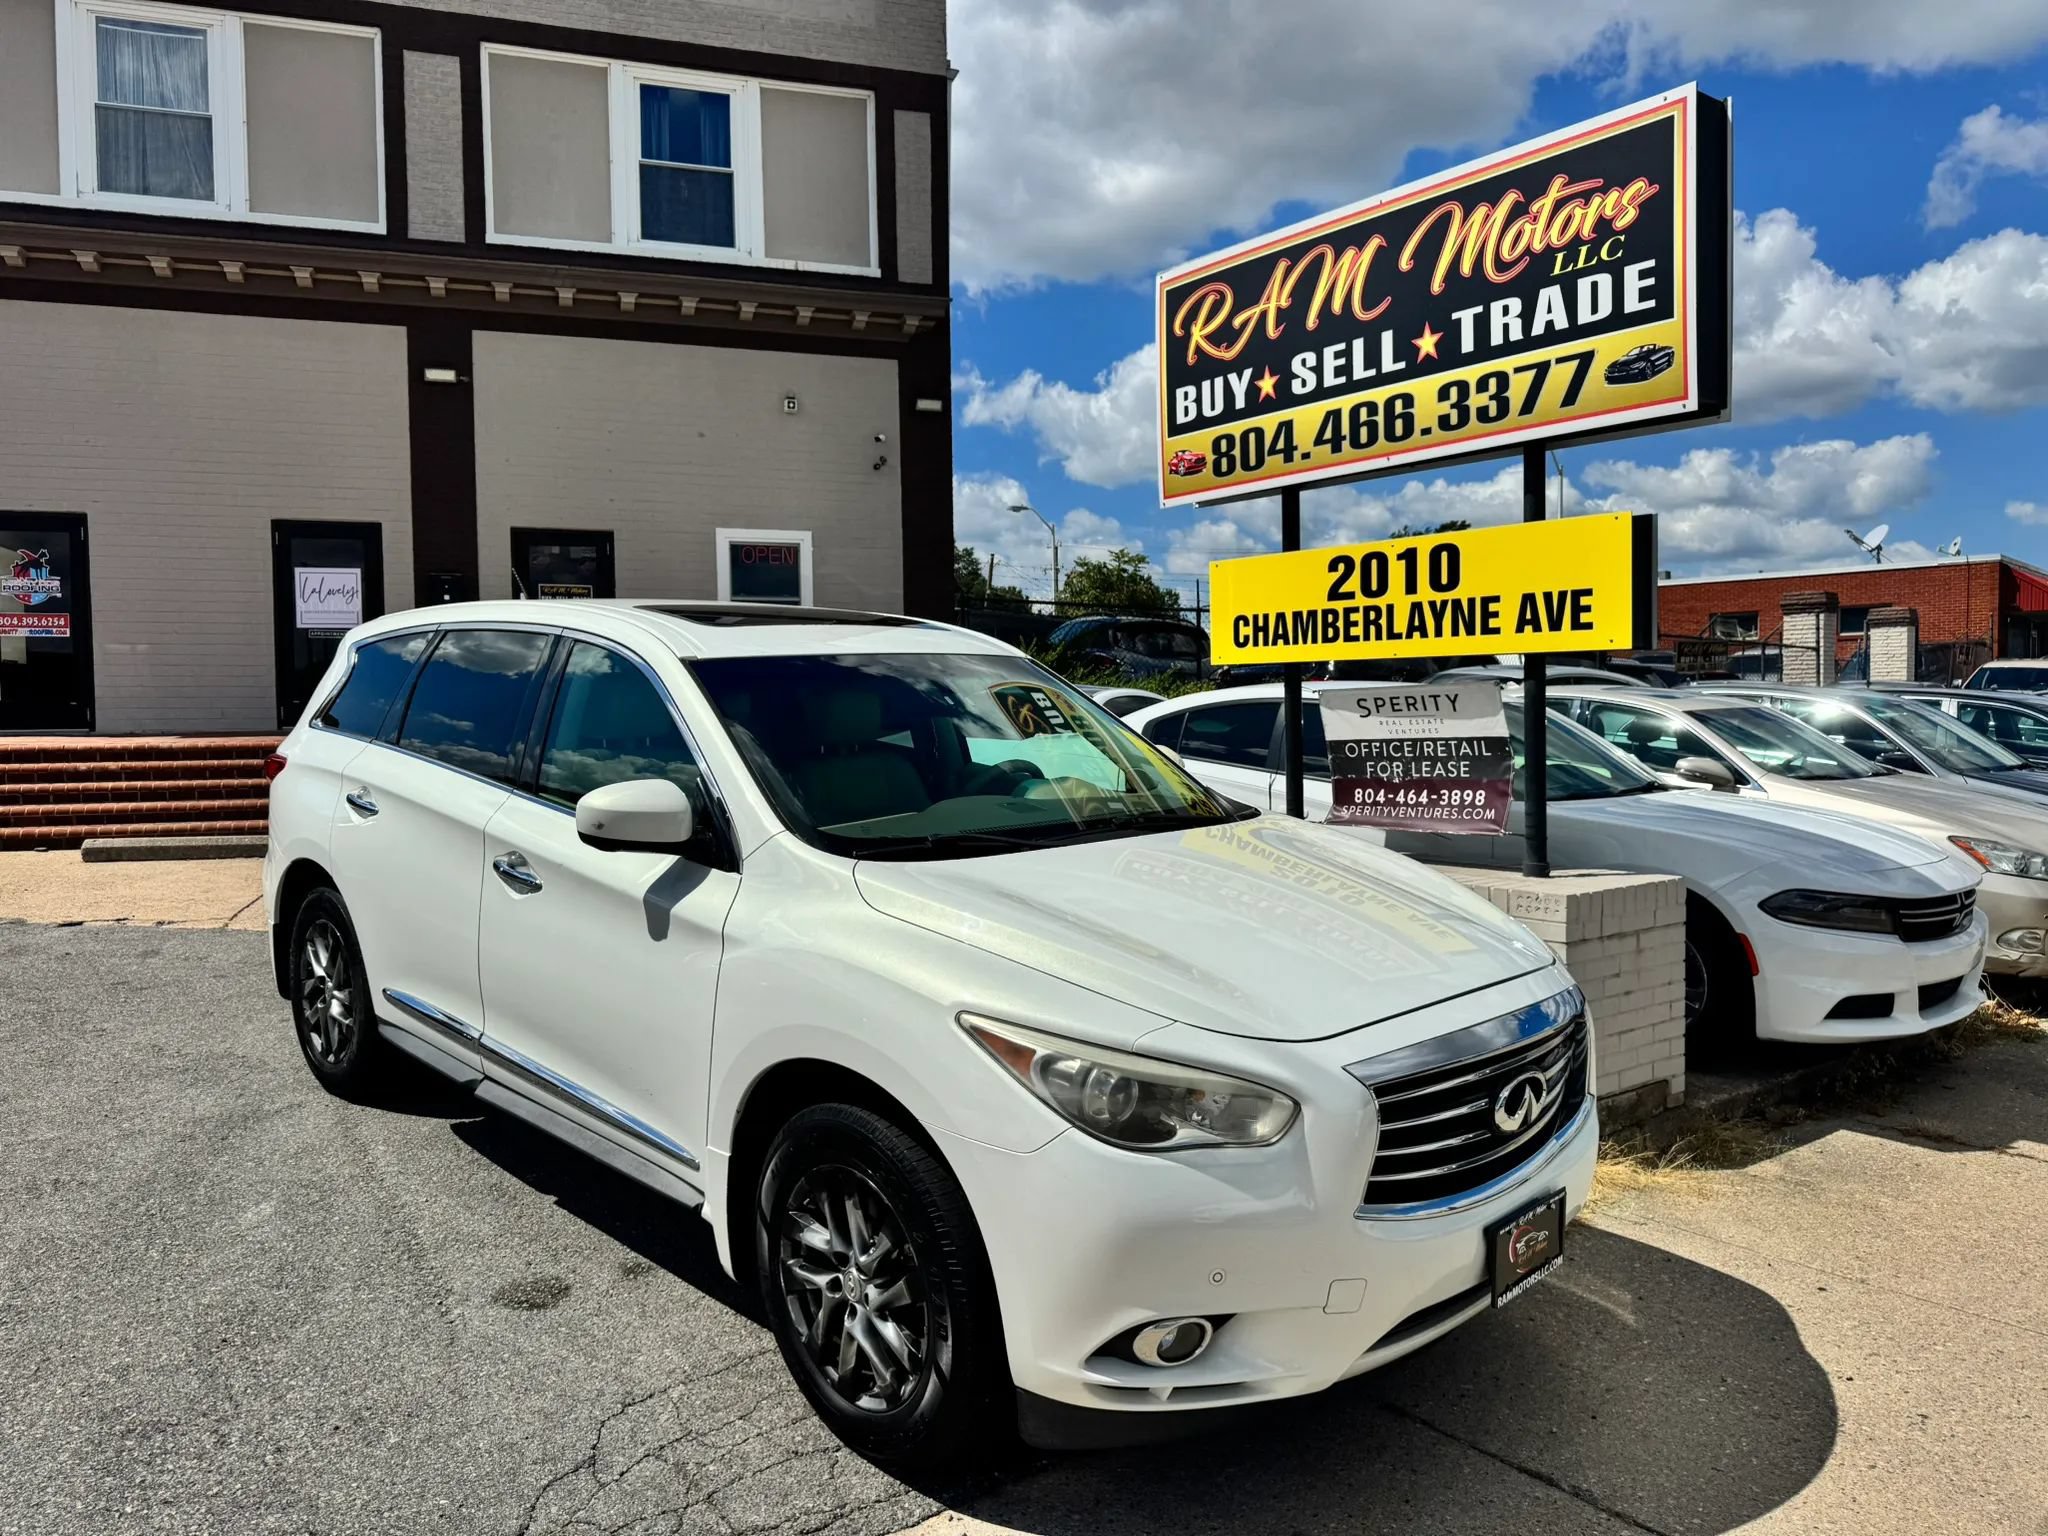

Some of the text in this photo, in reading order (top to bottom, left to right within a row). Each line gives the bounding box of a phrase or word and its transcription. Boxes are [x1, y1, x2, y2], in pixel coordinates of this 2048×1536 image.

[1551, 235, 1625, 276] LLC
[1174, 174, 1659, 364] RAM Motors
[1175, 258, 1657, 425] BUY SELL TRADE
[1211, 349, 1598, 478] 804.466.3377
[742, 546, 795, 565] OPEN
[1327, 542, 1461, 602] 2010
[3, 584, 60, 593] ROOFING
[1233, 588, 1594, 648] CHAMBERLAYNE AVE
[1356, 693, 1459, 718] SPERITY
[1409, 718, 1445, 726] ESTATE
[1345, 740, 1492, 758] OFFICE/RETAIL
[1366, 761, 1471, 778] FOR LEASE
[1354, 788, 1486, 806] 804-464-3898
[1341, 805, 1495, 820] SPERITYVENTURES.COM
[1497, 1254, 1564, 1309] RAMMOTORSLLC.COM
